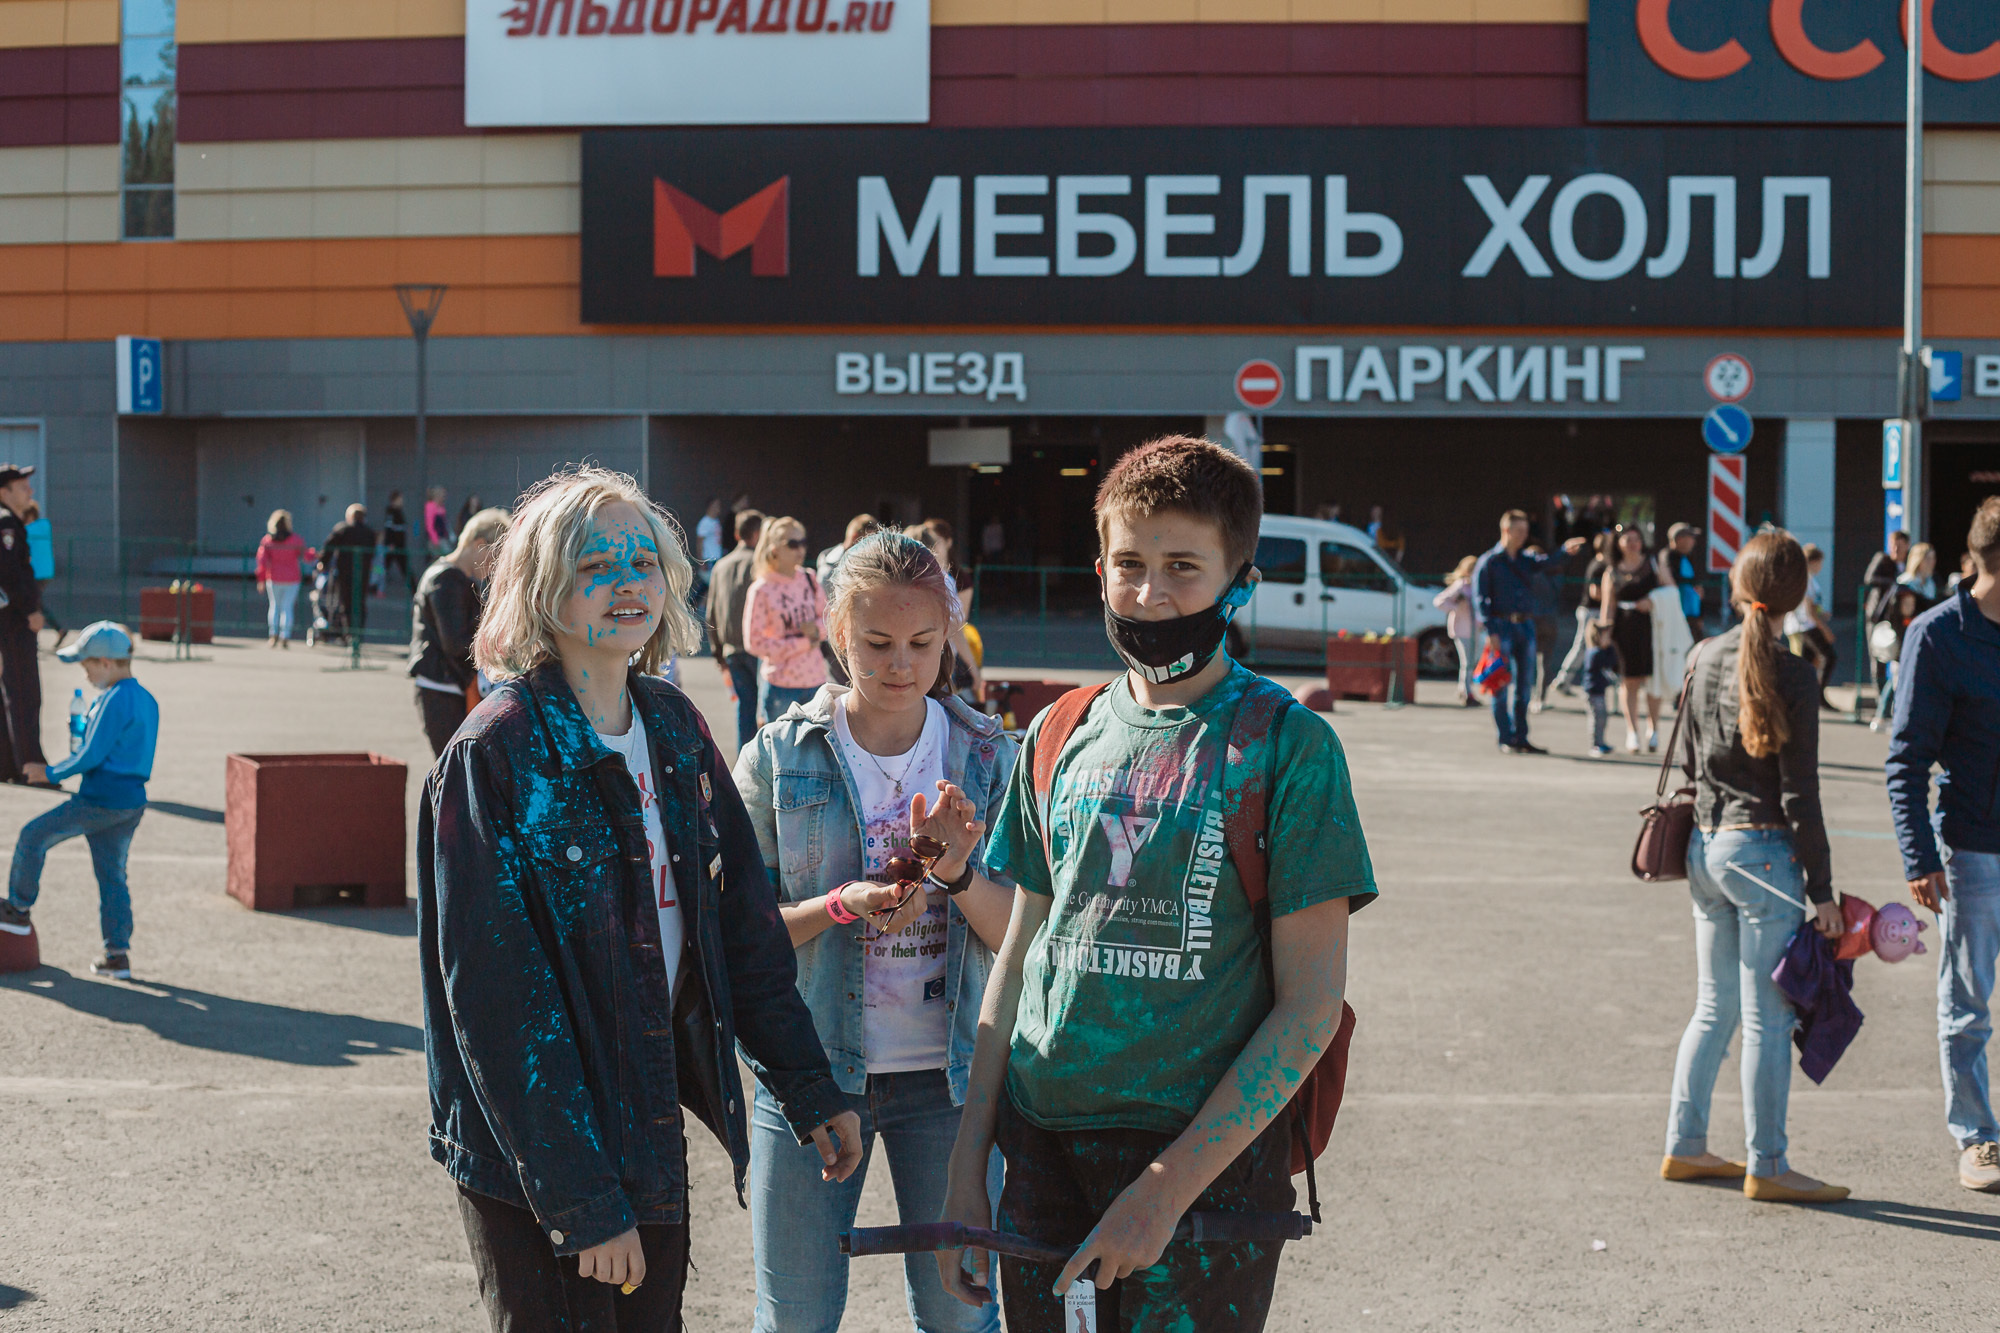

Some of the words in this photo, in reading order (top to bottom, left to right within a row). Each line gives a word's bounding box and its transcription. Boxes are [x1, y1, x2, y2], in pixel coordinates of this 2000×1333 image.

[857, 174, 1404, 277] МЕБЕЛЬ
[1461, 173, 1831, 280] ХОЛЛ
[835, 352, 1027, 401] ВЫЕЗД
[1295, 345, 1646, 402] ПАРКИНГ
[1078, 891, 1139, 916] Comuity
[1141, 897, 1180, 916] YMCA
[874, 946, 888, 958] or
[891, 942, 918, 958] their
